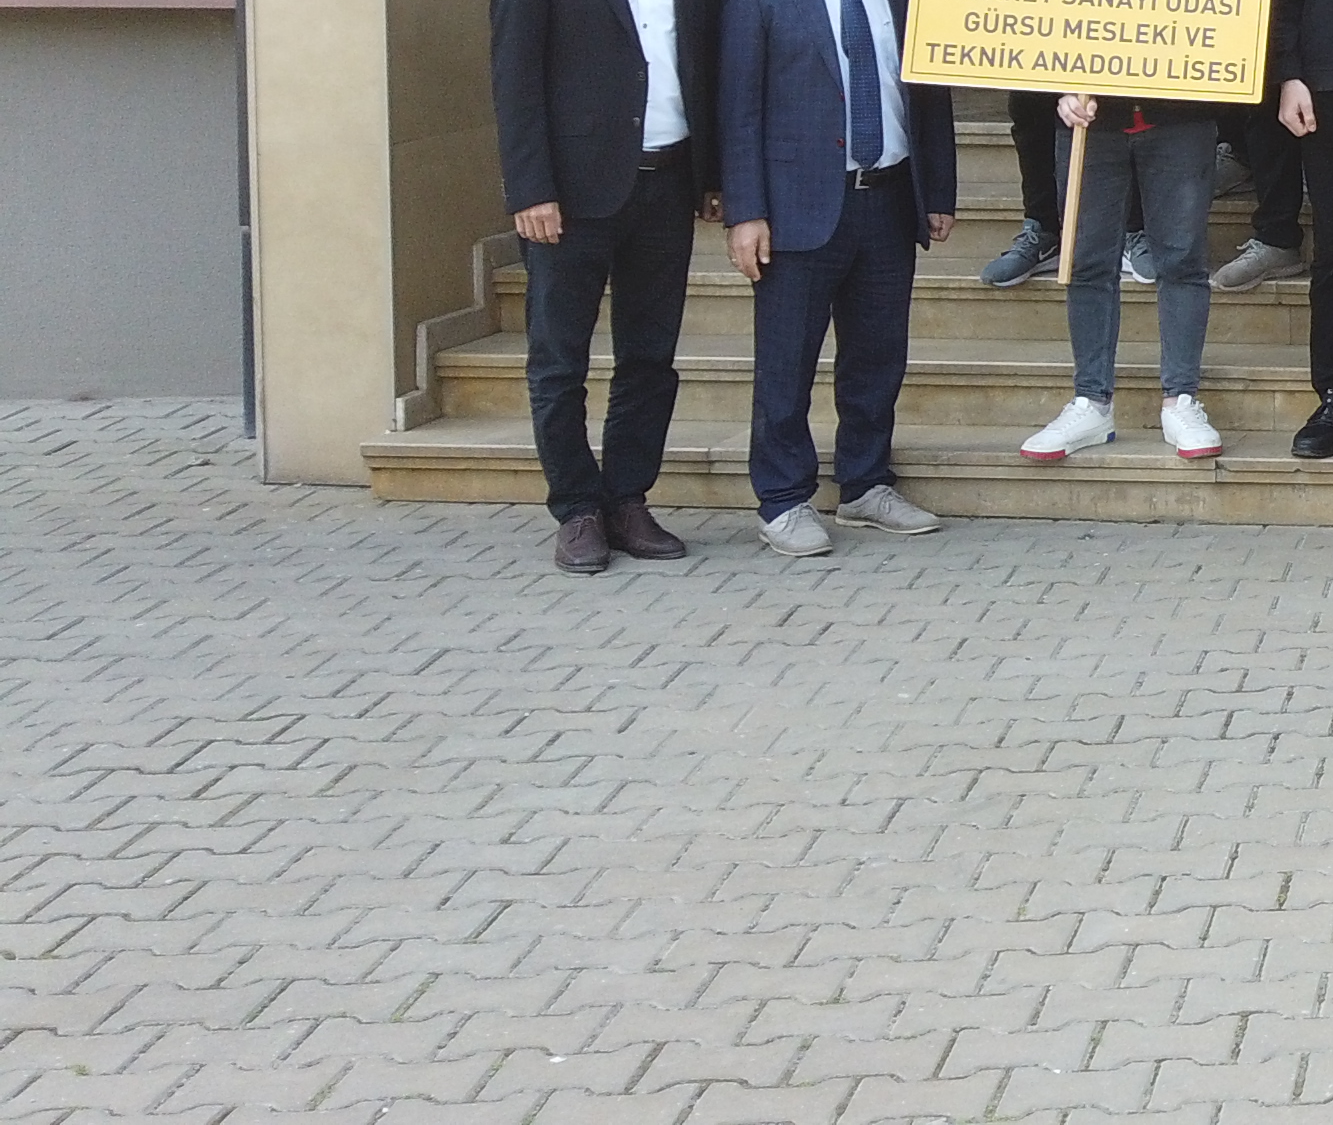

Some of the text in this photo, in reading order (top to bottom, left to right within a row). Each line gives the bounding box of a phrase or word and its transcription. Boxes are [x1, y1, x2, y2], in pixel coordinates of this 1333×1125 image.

[964, 7, 1217, 48] GÜRSU MESLEKİ VE
[925, 42, 1247, 84] TEKNİK ANADOLU LİSESİ
